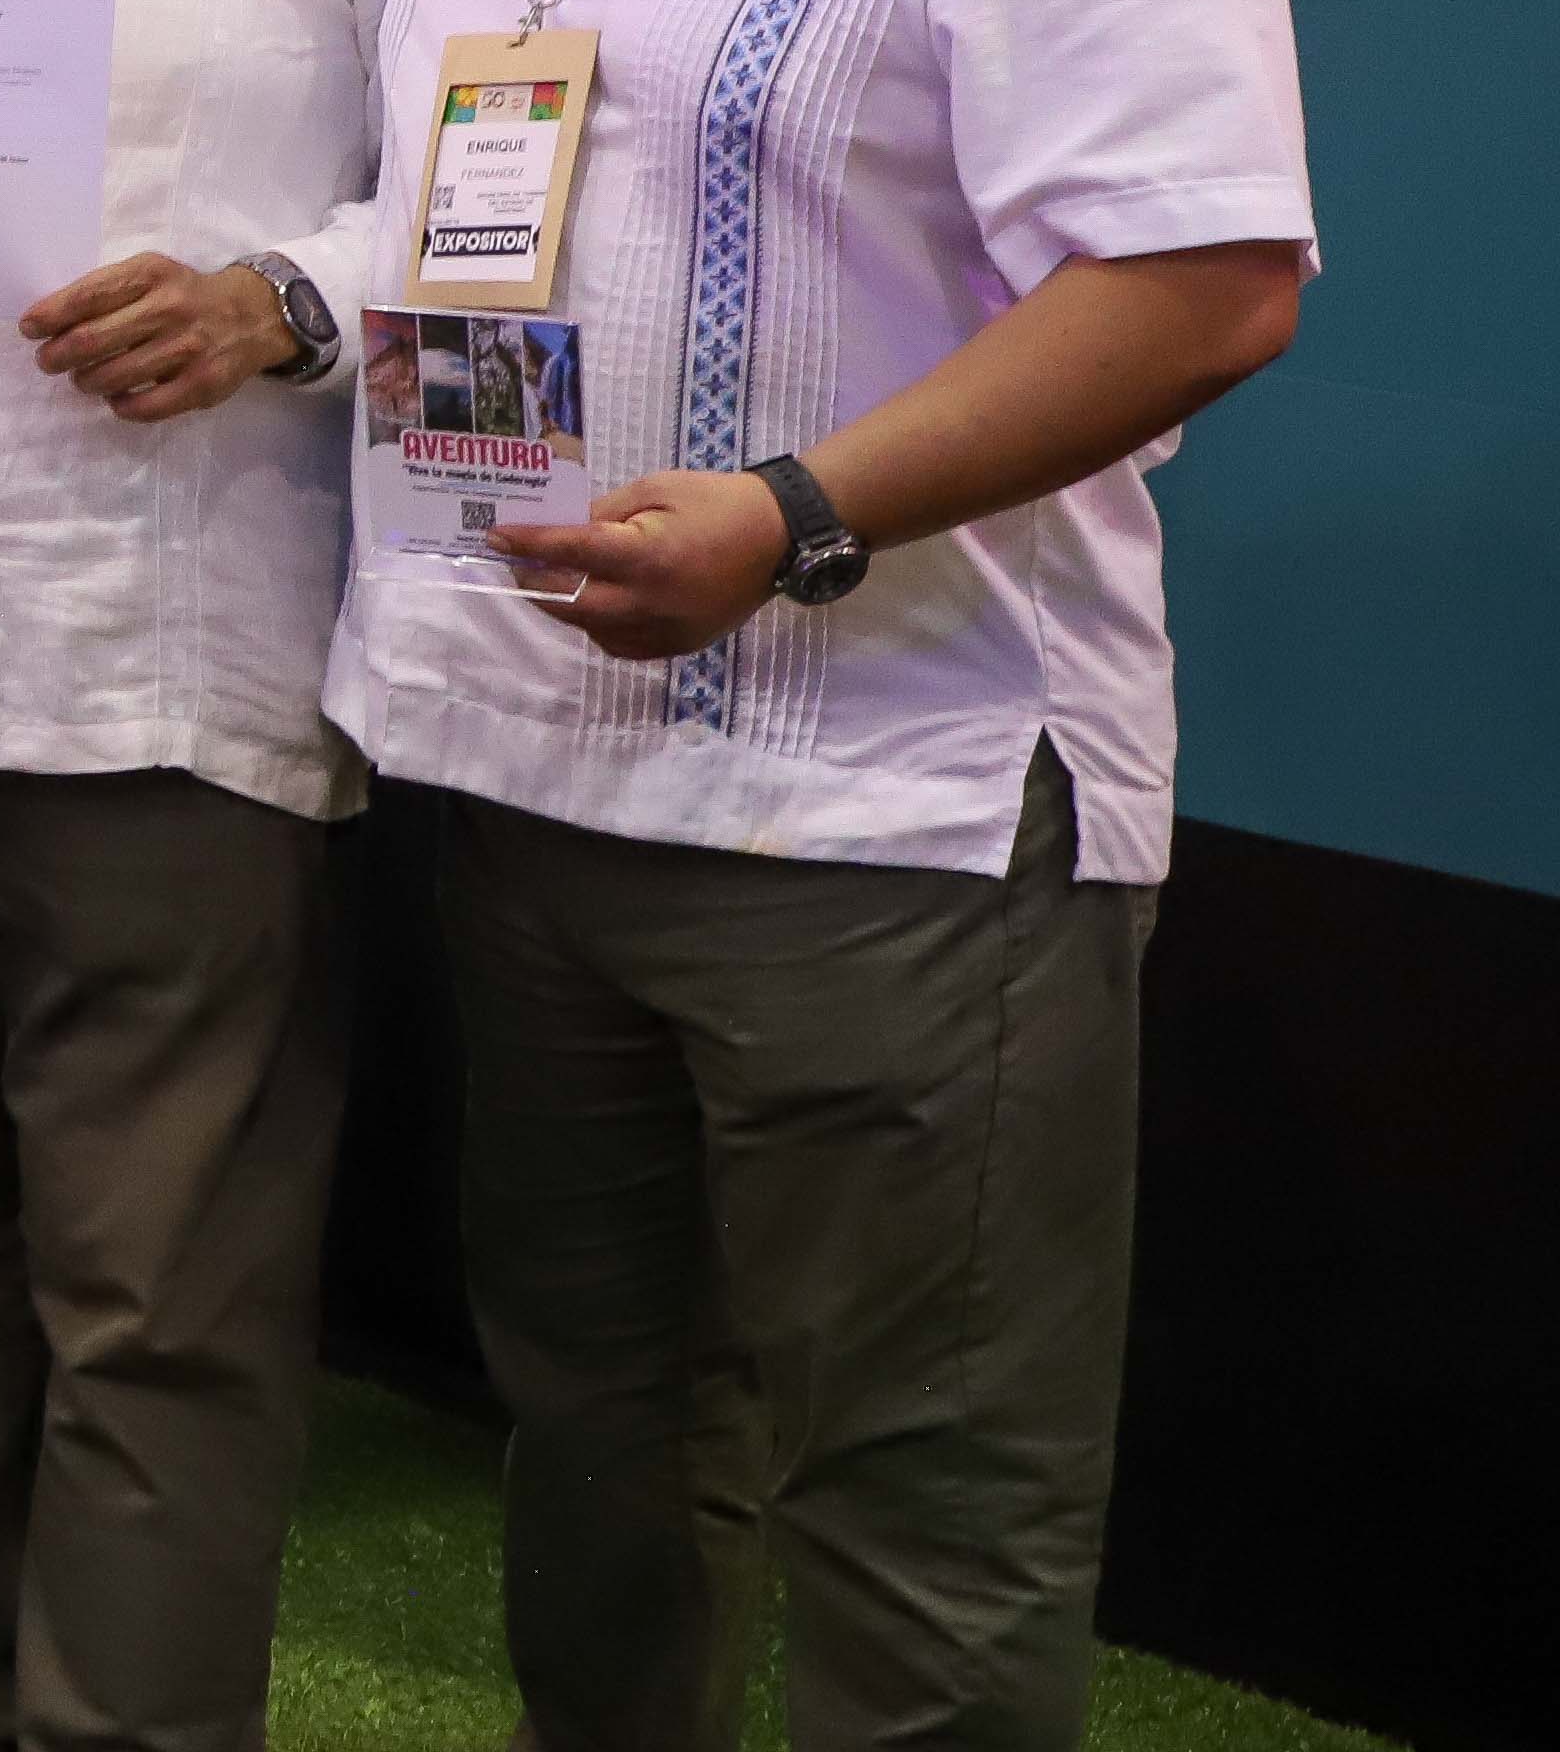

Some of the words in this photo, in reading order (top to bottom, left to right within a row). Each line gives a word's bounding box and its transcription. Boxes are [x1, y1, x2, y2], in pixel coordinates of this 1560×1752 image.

[466, 138, 528, 155] ENRIQUE
[433, 230, 531, 254] EXPOSITOR
[403, 431, 551, 470] AVENTURA
